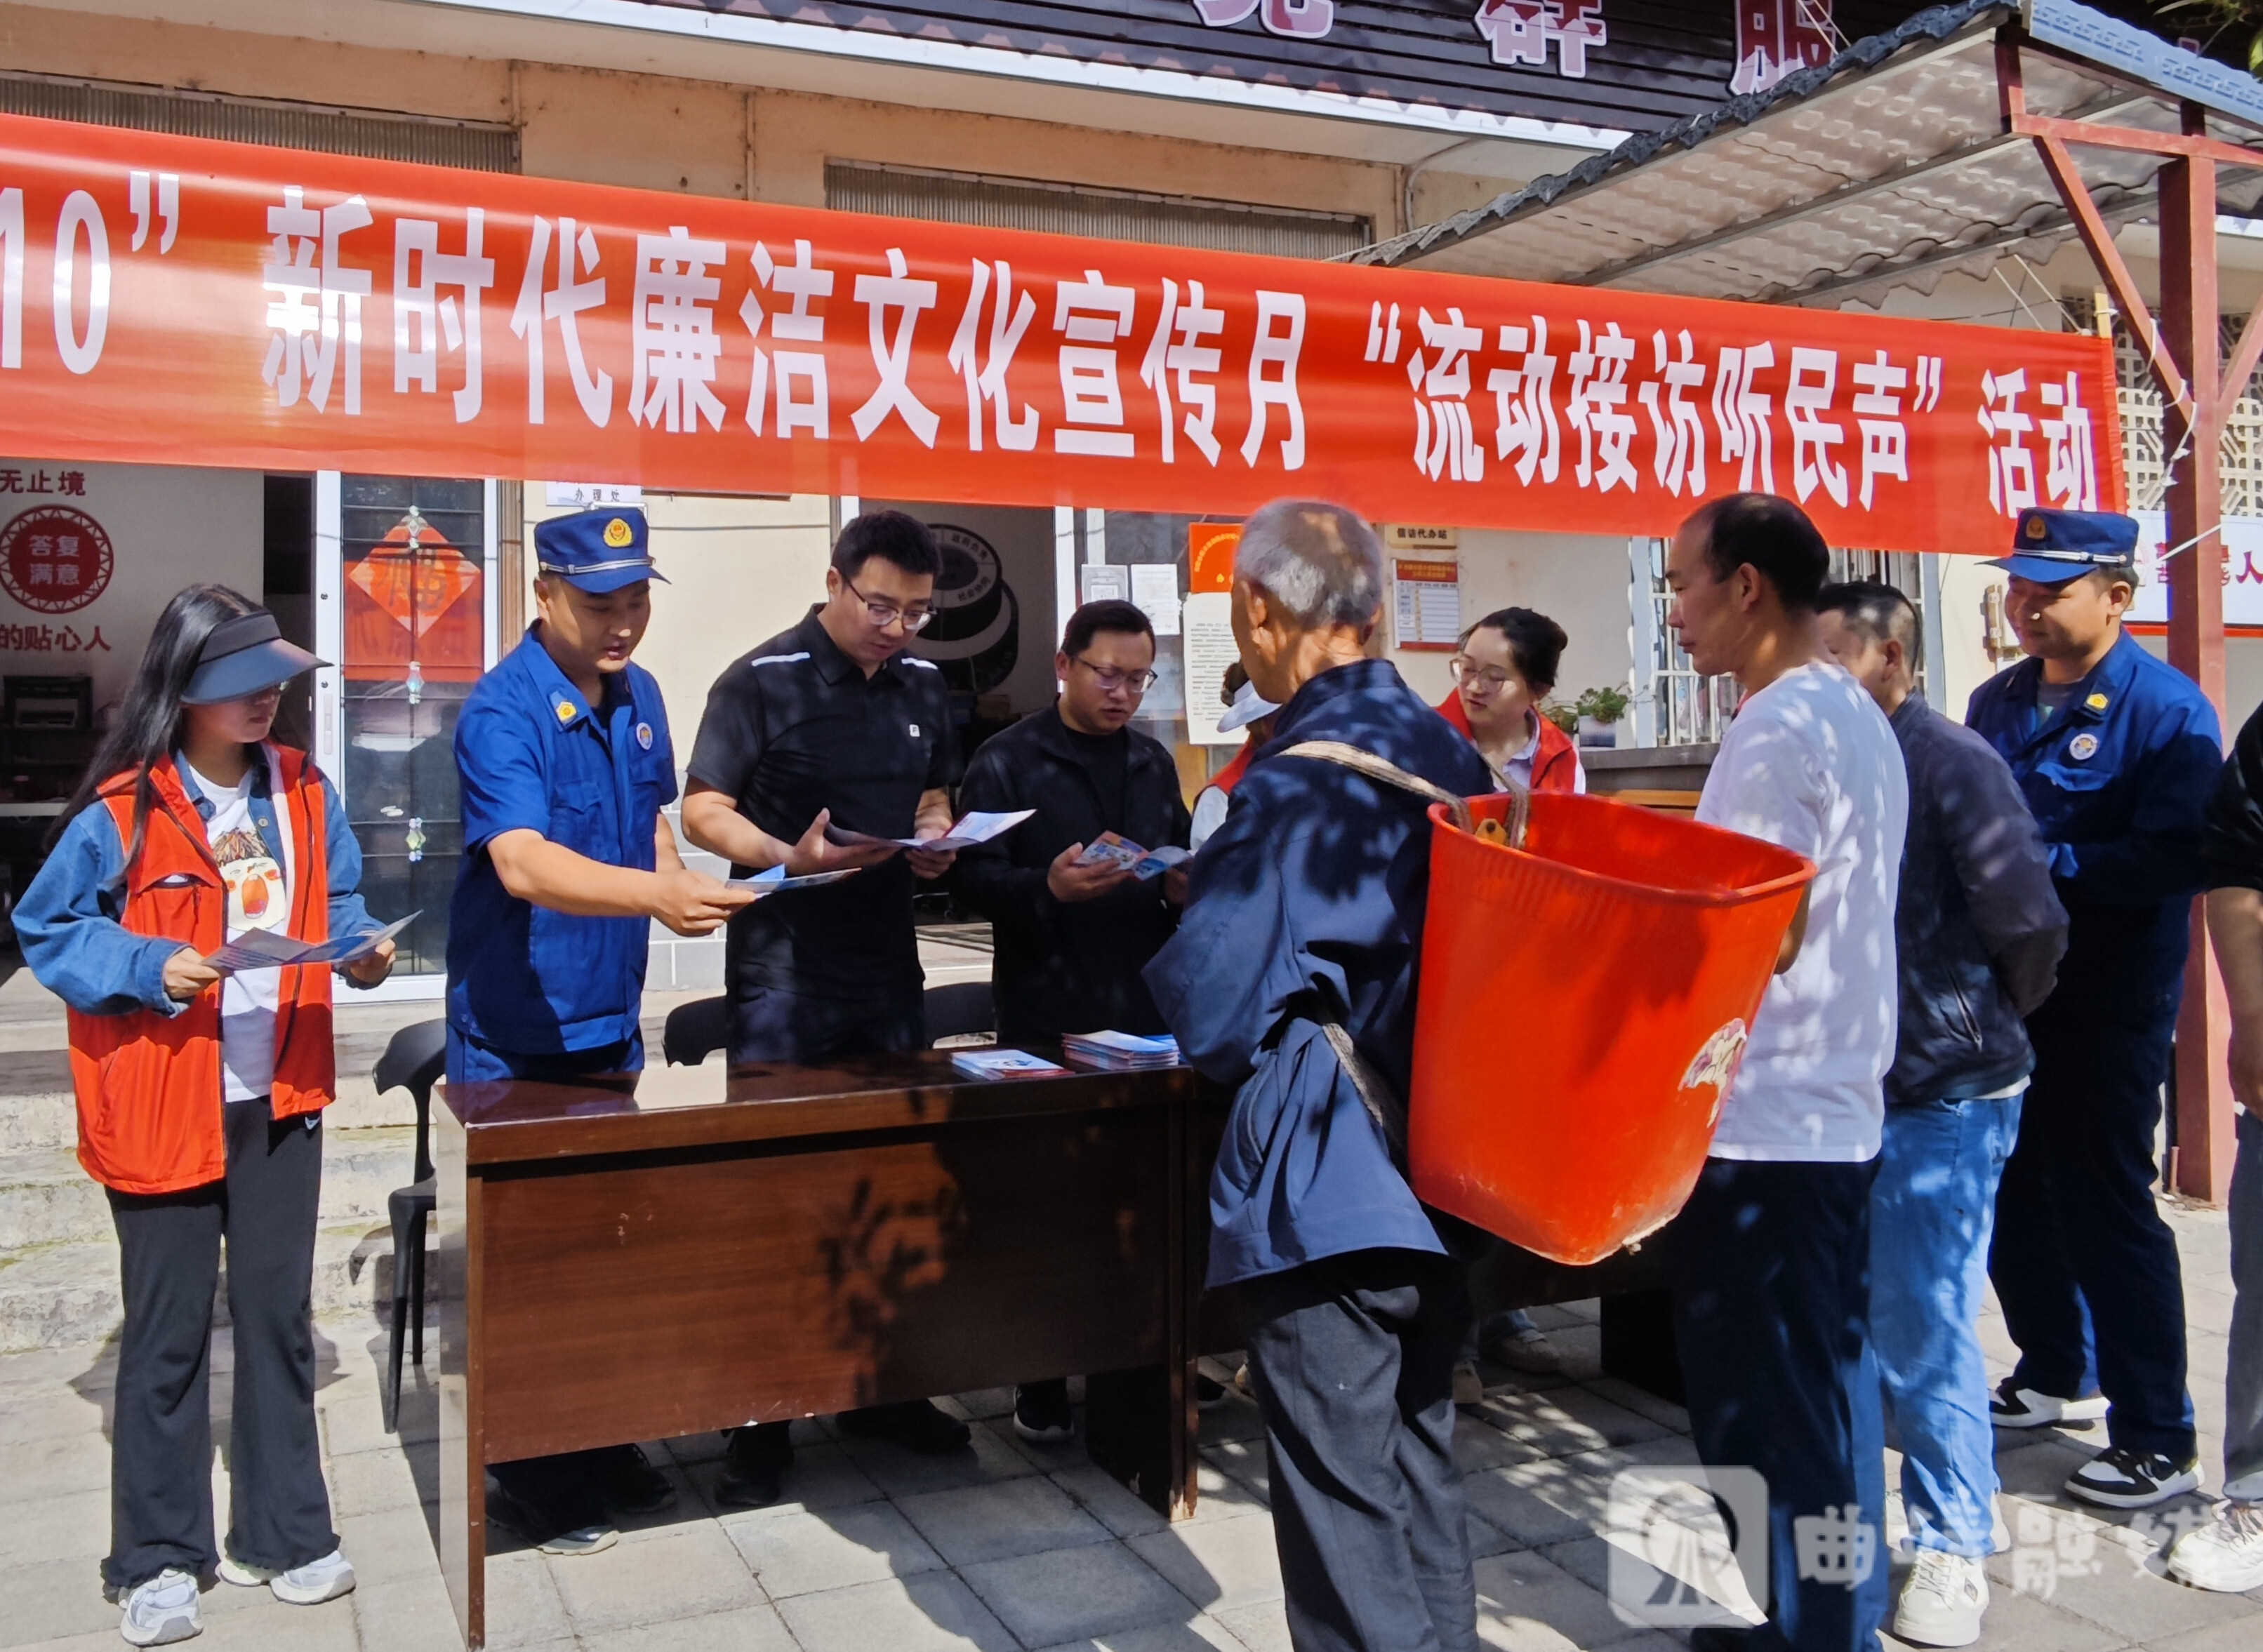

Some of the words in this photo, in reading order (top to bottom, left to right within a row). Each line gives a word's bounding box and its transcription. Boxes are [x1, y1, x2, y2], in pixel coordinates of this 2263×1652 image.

[0, 469, 86, 495] 无止境
[0, 624, 112, 651] 的贴心人
